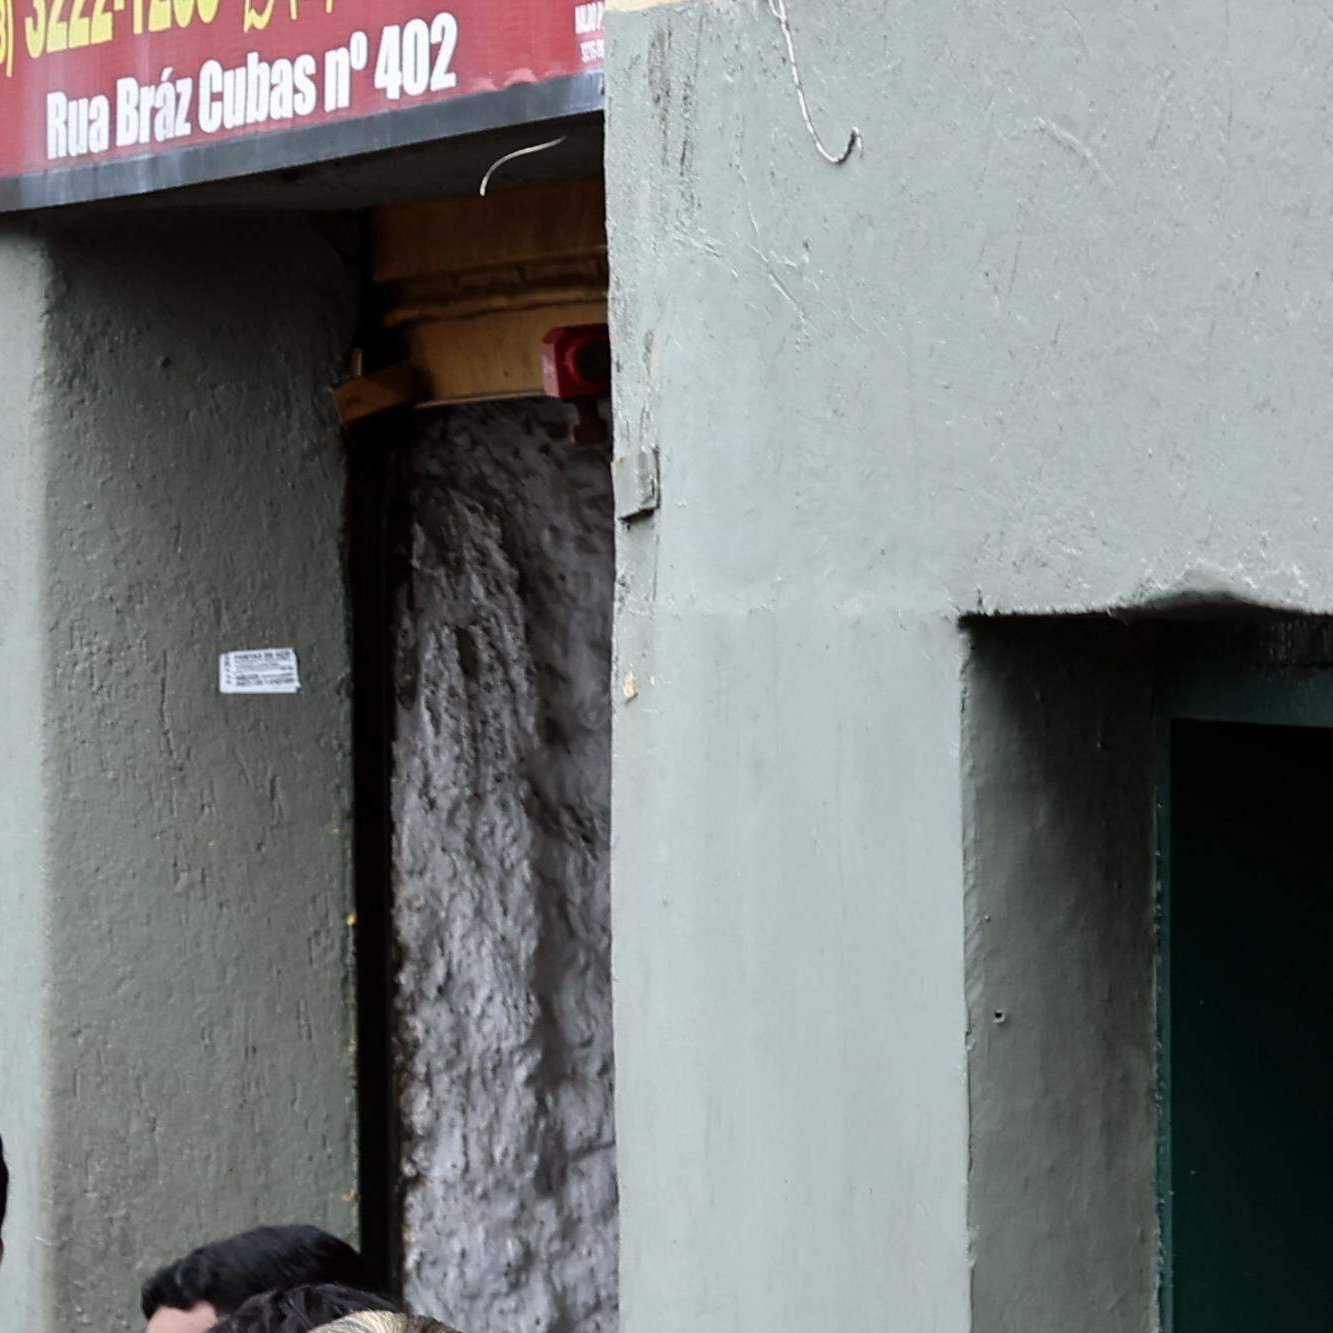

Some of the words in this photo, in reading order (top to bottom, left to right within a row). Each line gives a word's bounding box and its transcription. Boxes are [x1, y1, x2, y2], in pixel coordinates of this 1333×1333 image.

[46, 91, 110, 160] Rua
[116, 66, 193, 147] Bráz
[198, 51, 317, 133] Cubas
[374, 12, 458, 100] 402
